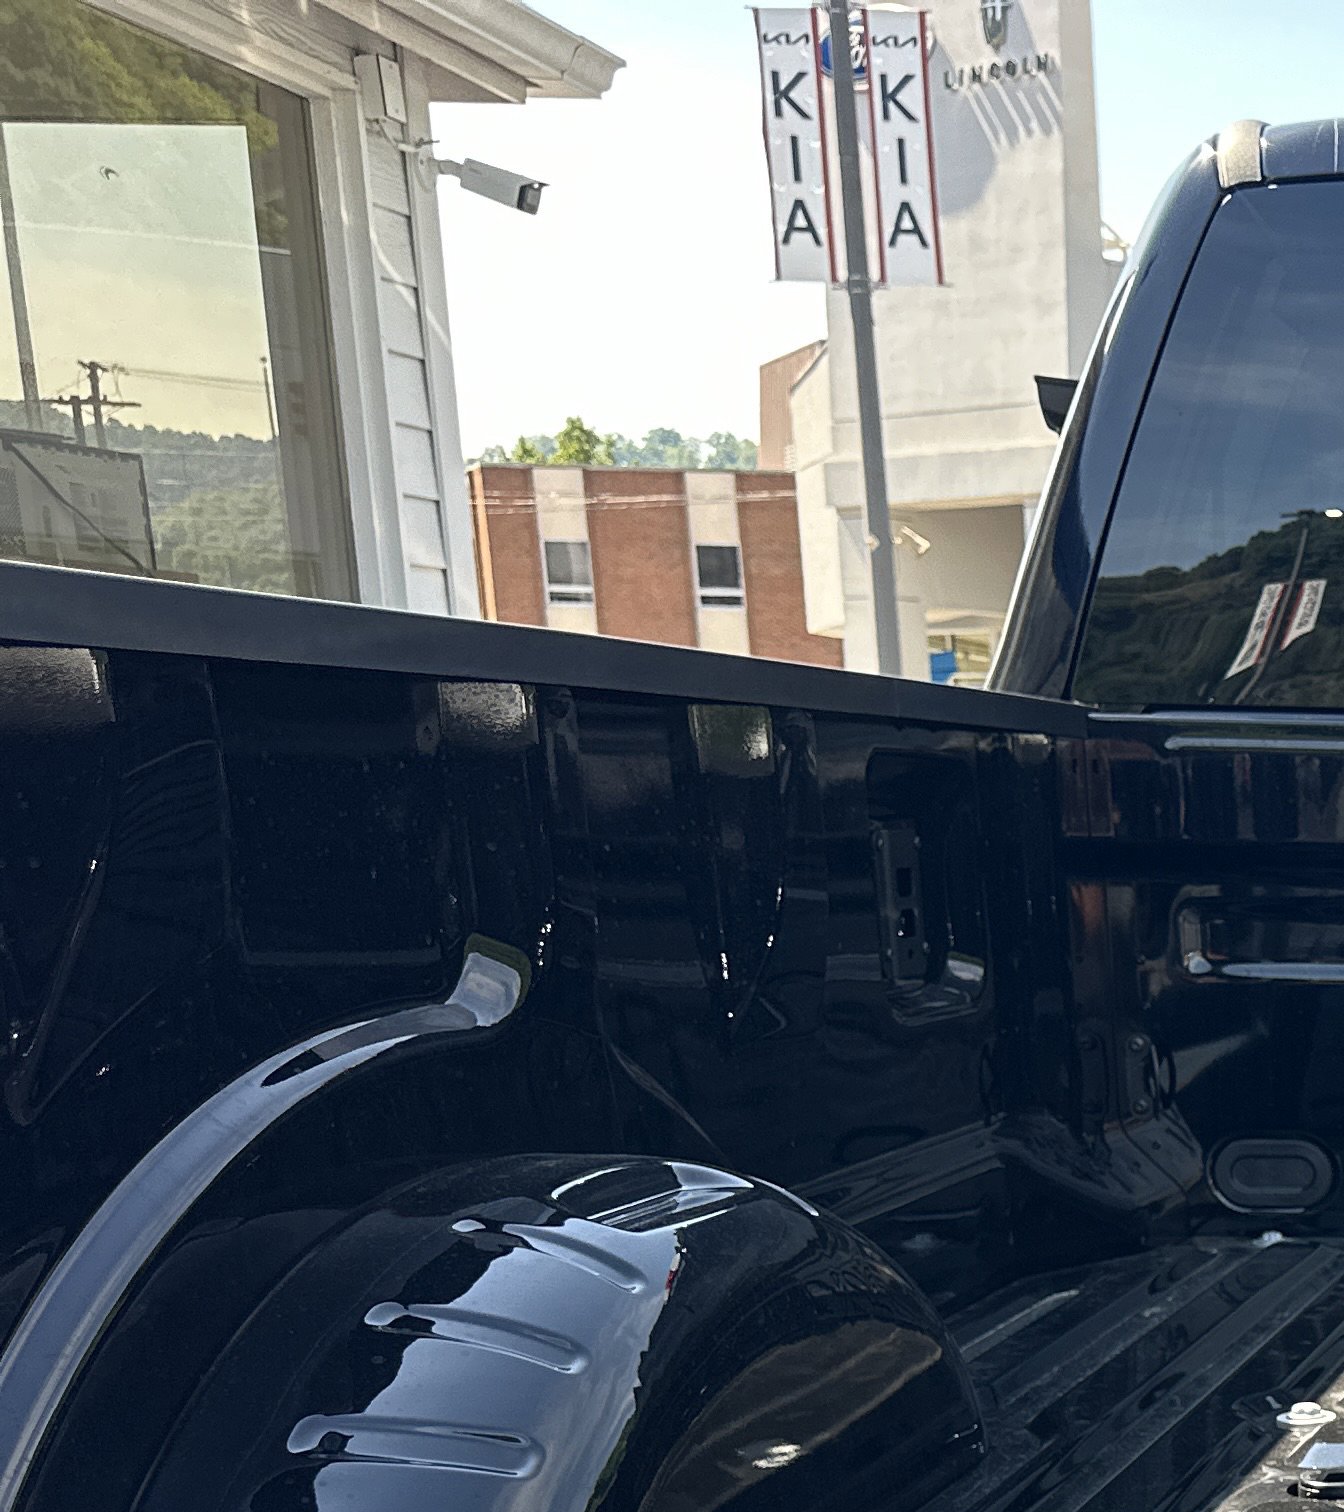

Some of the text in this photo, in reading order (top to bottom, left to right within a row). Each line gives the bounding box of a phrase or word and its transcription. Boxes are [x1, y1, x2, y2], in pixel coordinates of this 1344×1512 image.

[771, 69, 823, 248] KIA
[943, 53, 1048, 89] LINCOLN
[879, 73, 930, 249] KIA
